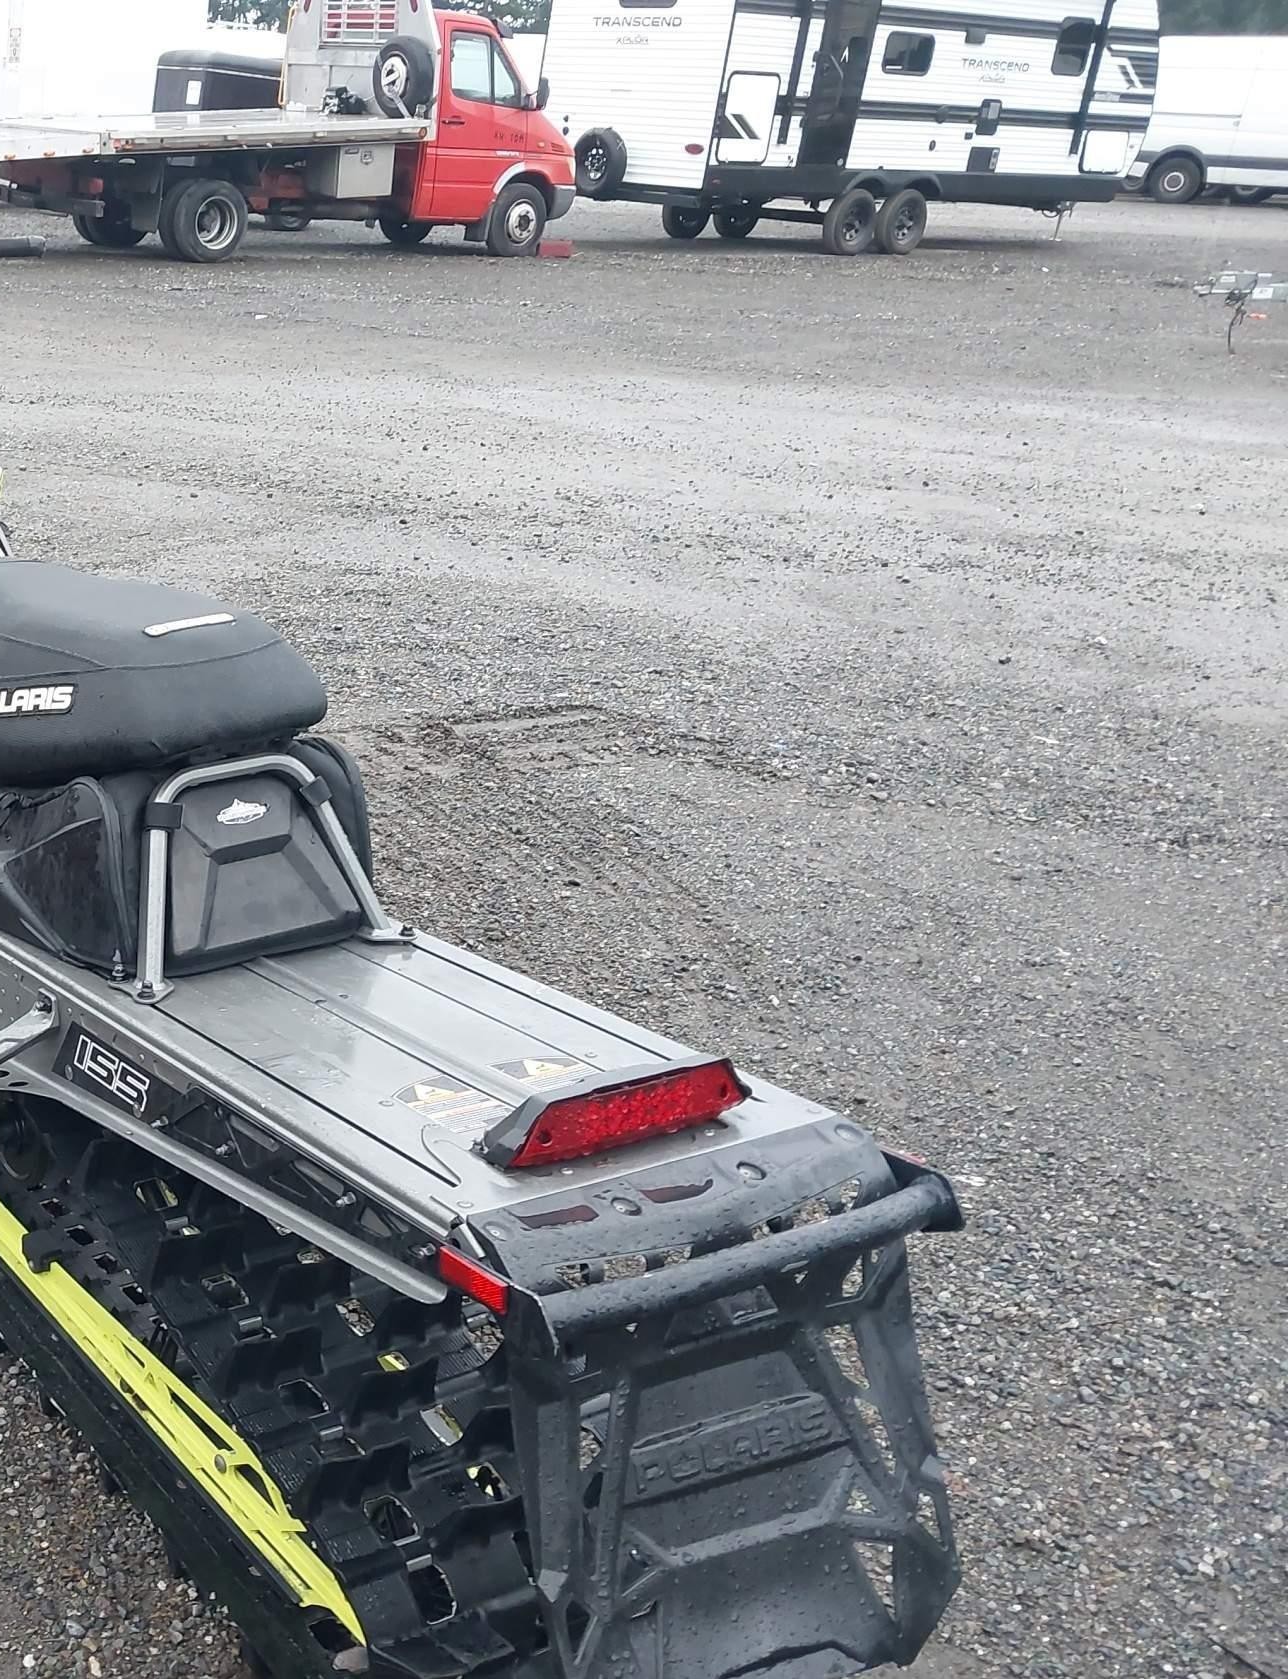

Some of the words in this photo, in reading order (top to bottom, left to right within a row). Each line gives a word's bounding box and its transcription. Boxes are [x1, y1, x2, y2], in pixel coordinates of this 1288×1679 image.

[592, 16, 683, 27] TRANSCEND
[962, 58, 1030, 72] TRANSCEND
[73, 1034, 150, 1112] 155
[632, 1402, 833, 1494] POLARIS
